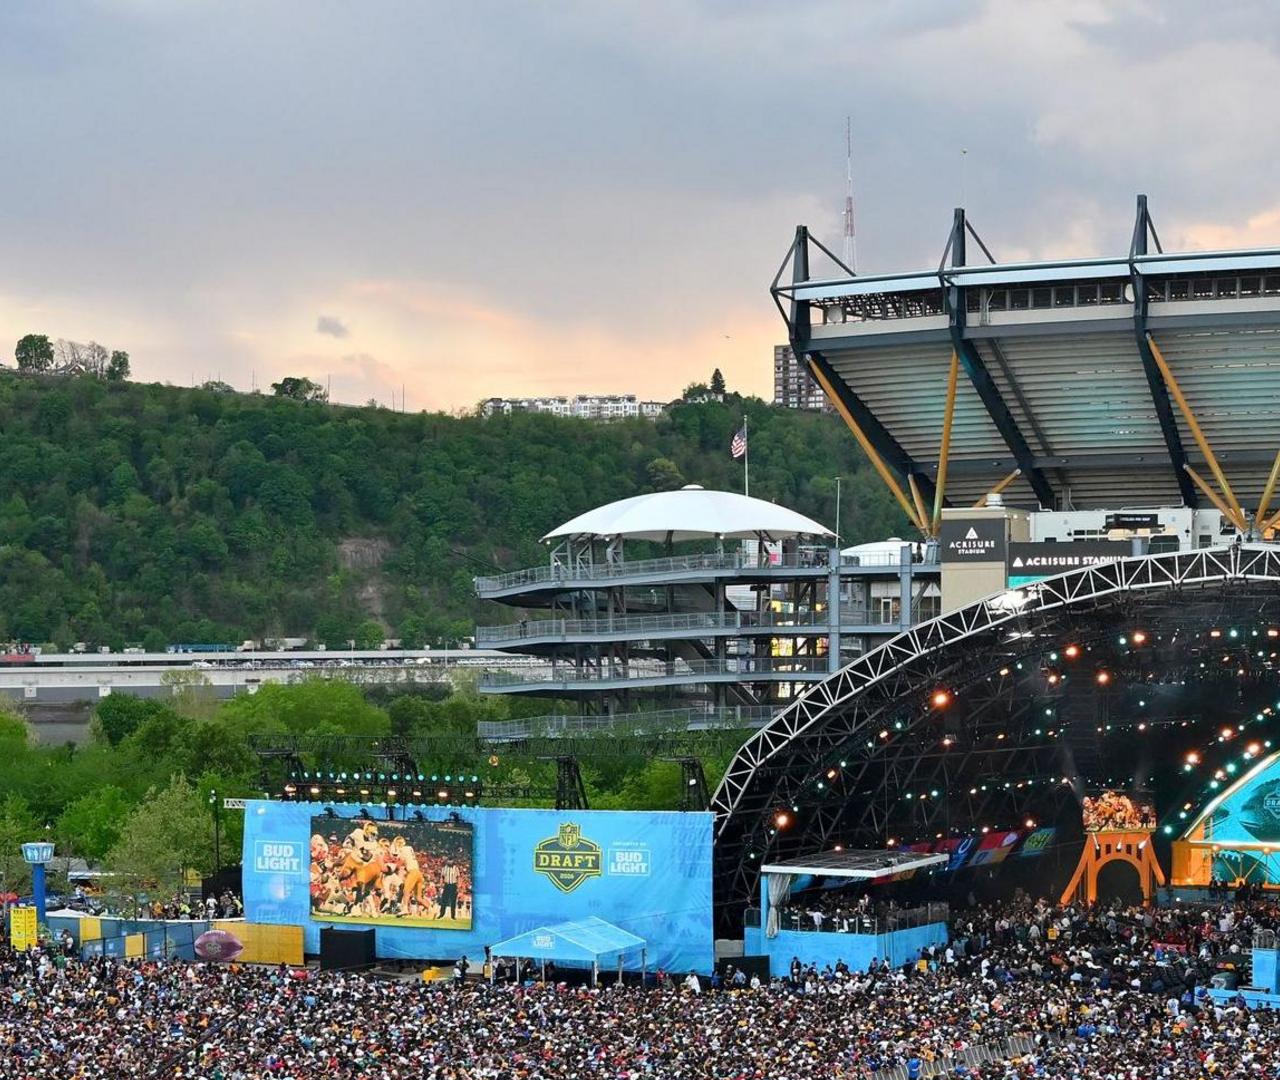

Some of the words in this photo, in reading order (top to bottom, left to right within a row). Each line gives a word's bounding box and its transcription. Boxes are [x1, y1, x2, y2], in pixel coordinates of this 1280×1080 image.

[949, 540, 995, 548] ACRISURE
[1026, 556, 1080, 566] ACRISURE
[264, 844, 294, 857] BUD
[540, 854, 596, 867] DRAFT
[616, 852, 642, 862] BUD
[258, 857, 300, 871] LIGHT
[610, 862, 648, 873] LIGHT
